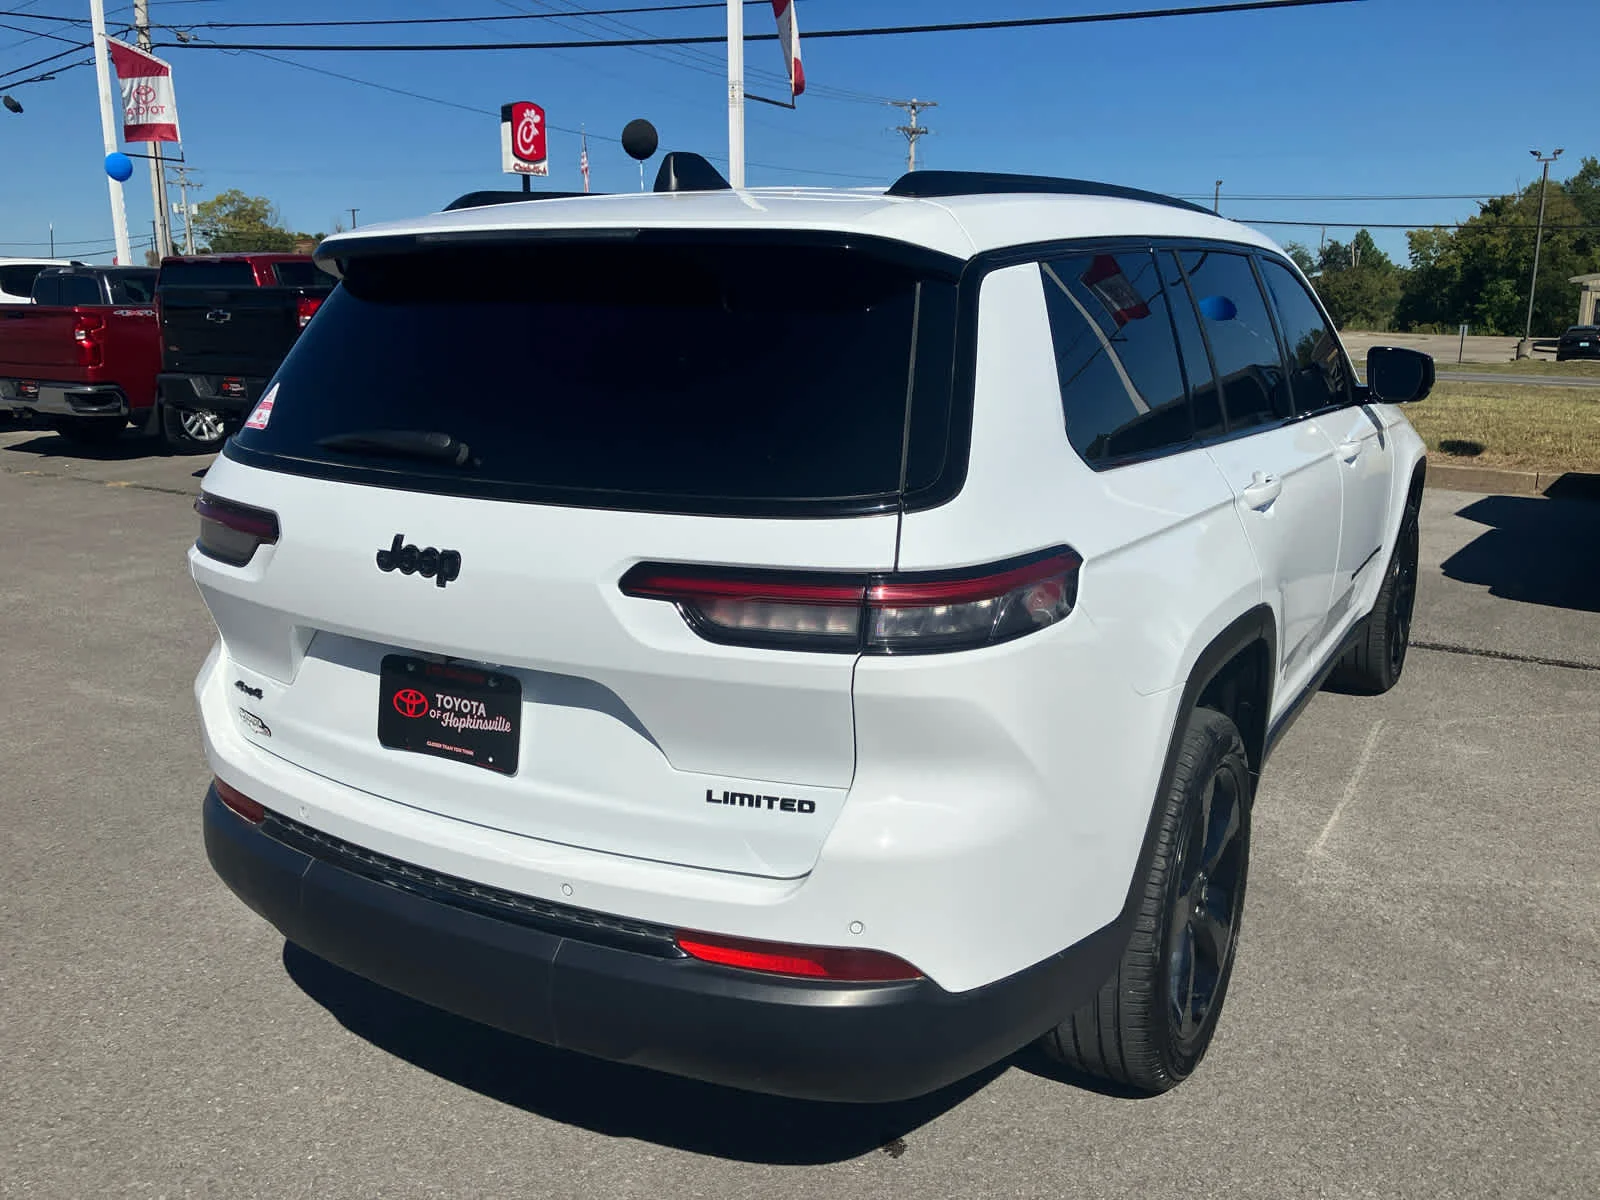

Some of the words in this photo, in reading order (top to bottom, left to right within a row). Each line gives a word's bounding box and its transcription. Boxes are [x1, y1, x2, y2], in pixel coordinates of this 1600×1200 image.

[376, 533, 462, 588] Jeep
[435, 693, 486, 717] TOYOTA
[429, 709, 442, 719] OF
[441, 711, 512, 733] Hopkinsville
[705, 789, 816, 814] LIMITED
